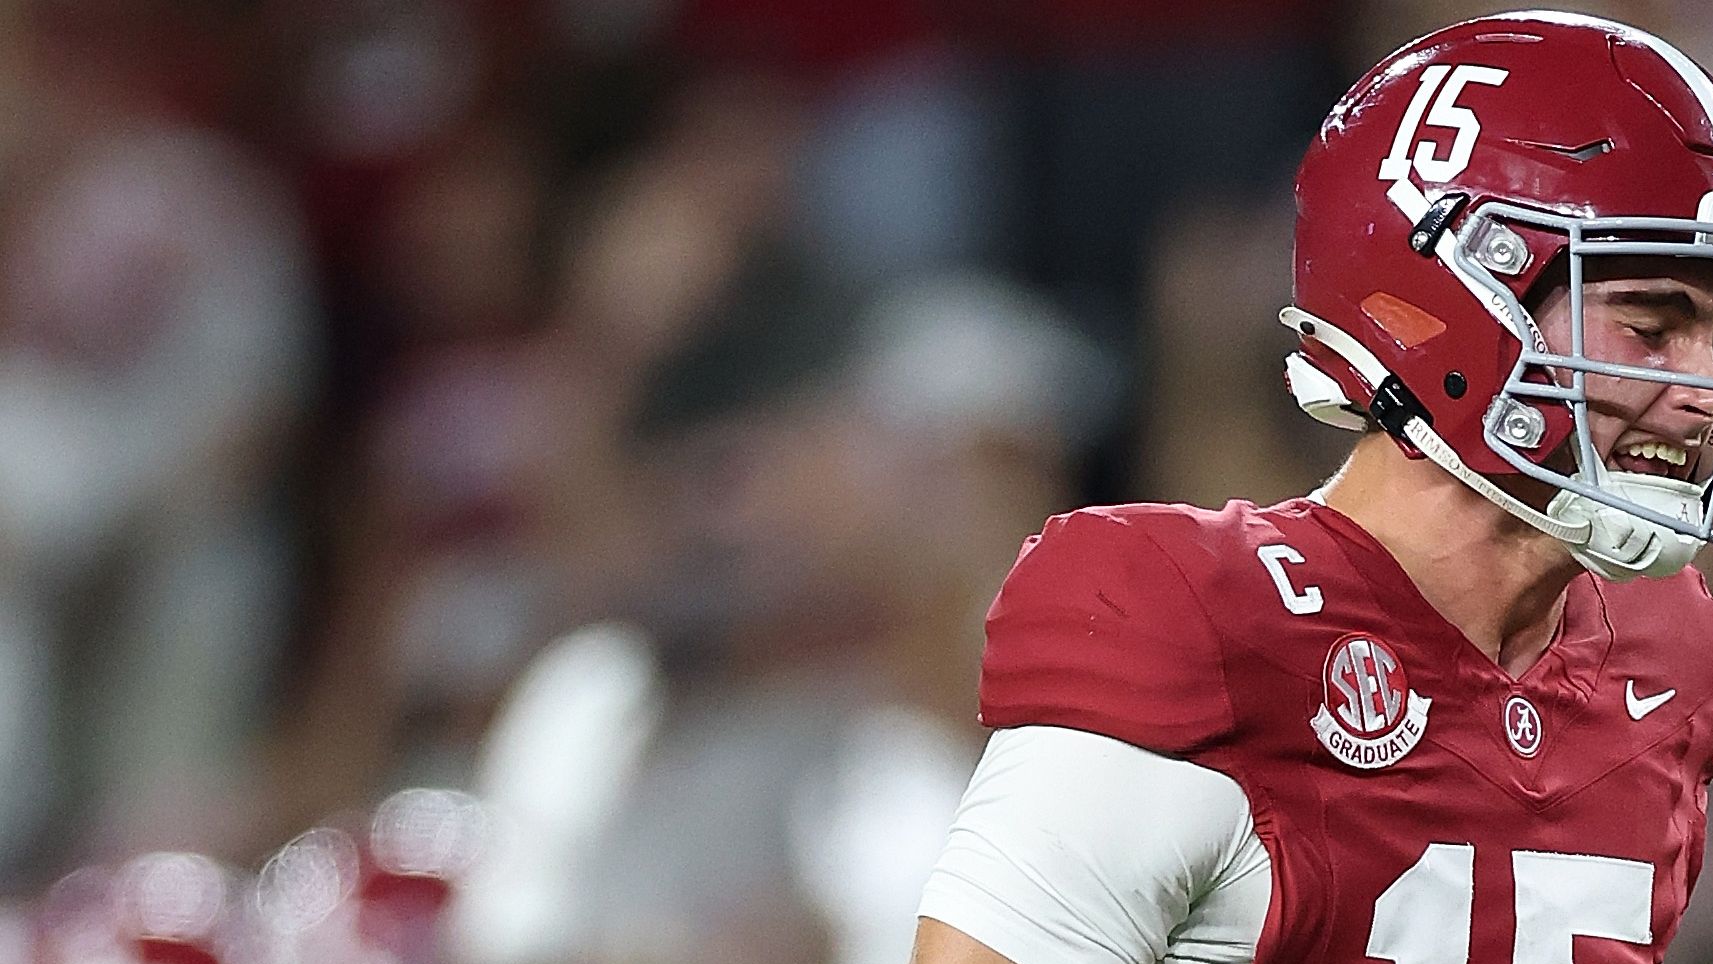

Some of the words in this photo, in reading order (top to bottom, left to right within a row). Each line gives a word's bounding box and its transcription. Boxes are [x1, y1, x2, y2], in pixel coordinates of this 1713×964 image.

[1379, 63, 1510, 184] 15
[1256, 544, 1325, 615] C
[1331, 638, 1402, 732] SEC
[1329, 718, 1420, 764] GRADUATE
[1511, 705, 1535, 741] A
